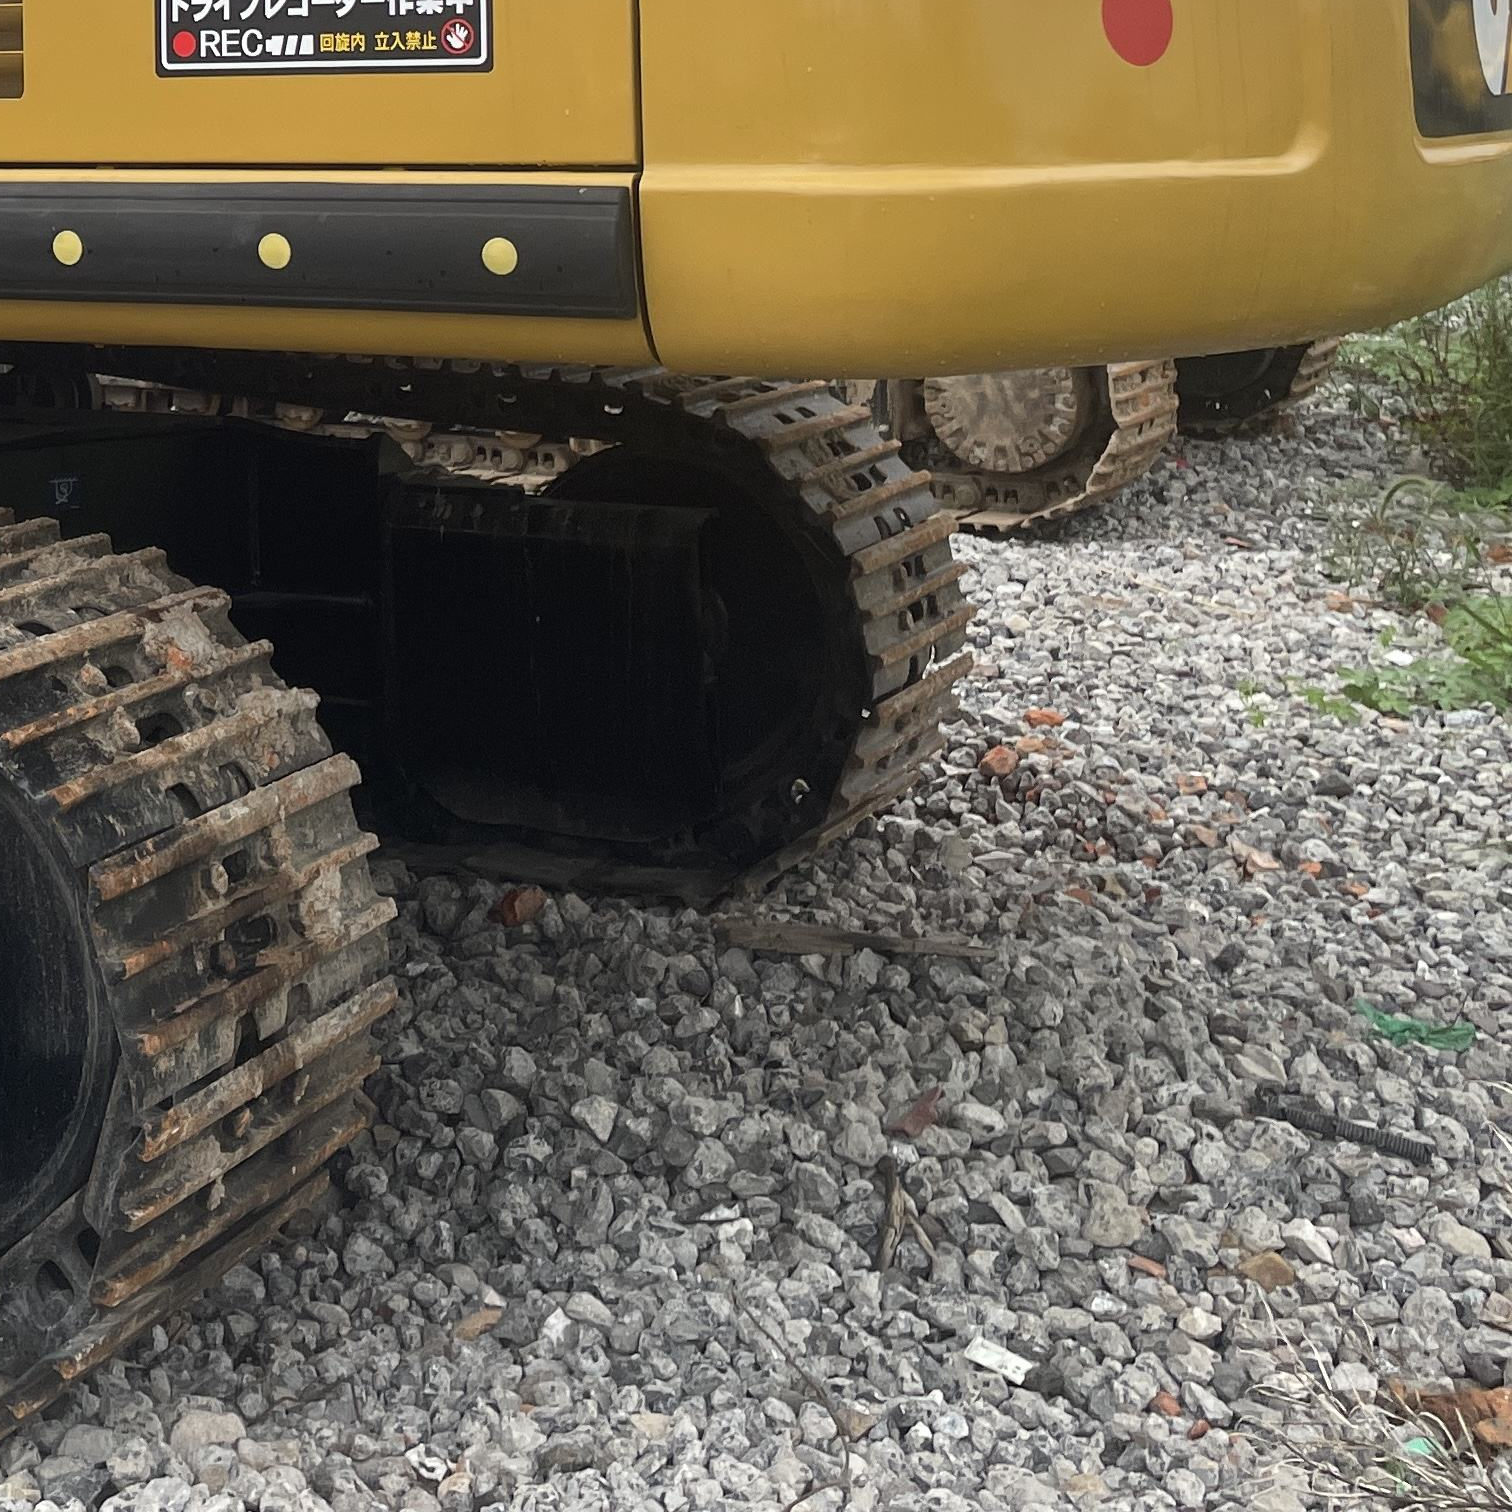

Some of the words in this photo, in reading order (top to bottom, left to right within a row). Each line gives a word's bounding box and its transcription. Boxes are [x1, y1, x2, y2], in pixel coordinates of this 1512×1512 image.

[200, 28, 264, 58] REC
[374, 30, 438, 51] 立入禁止
